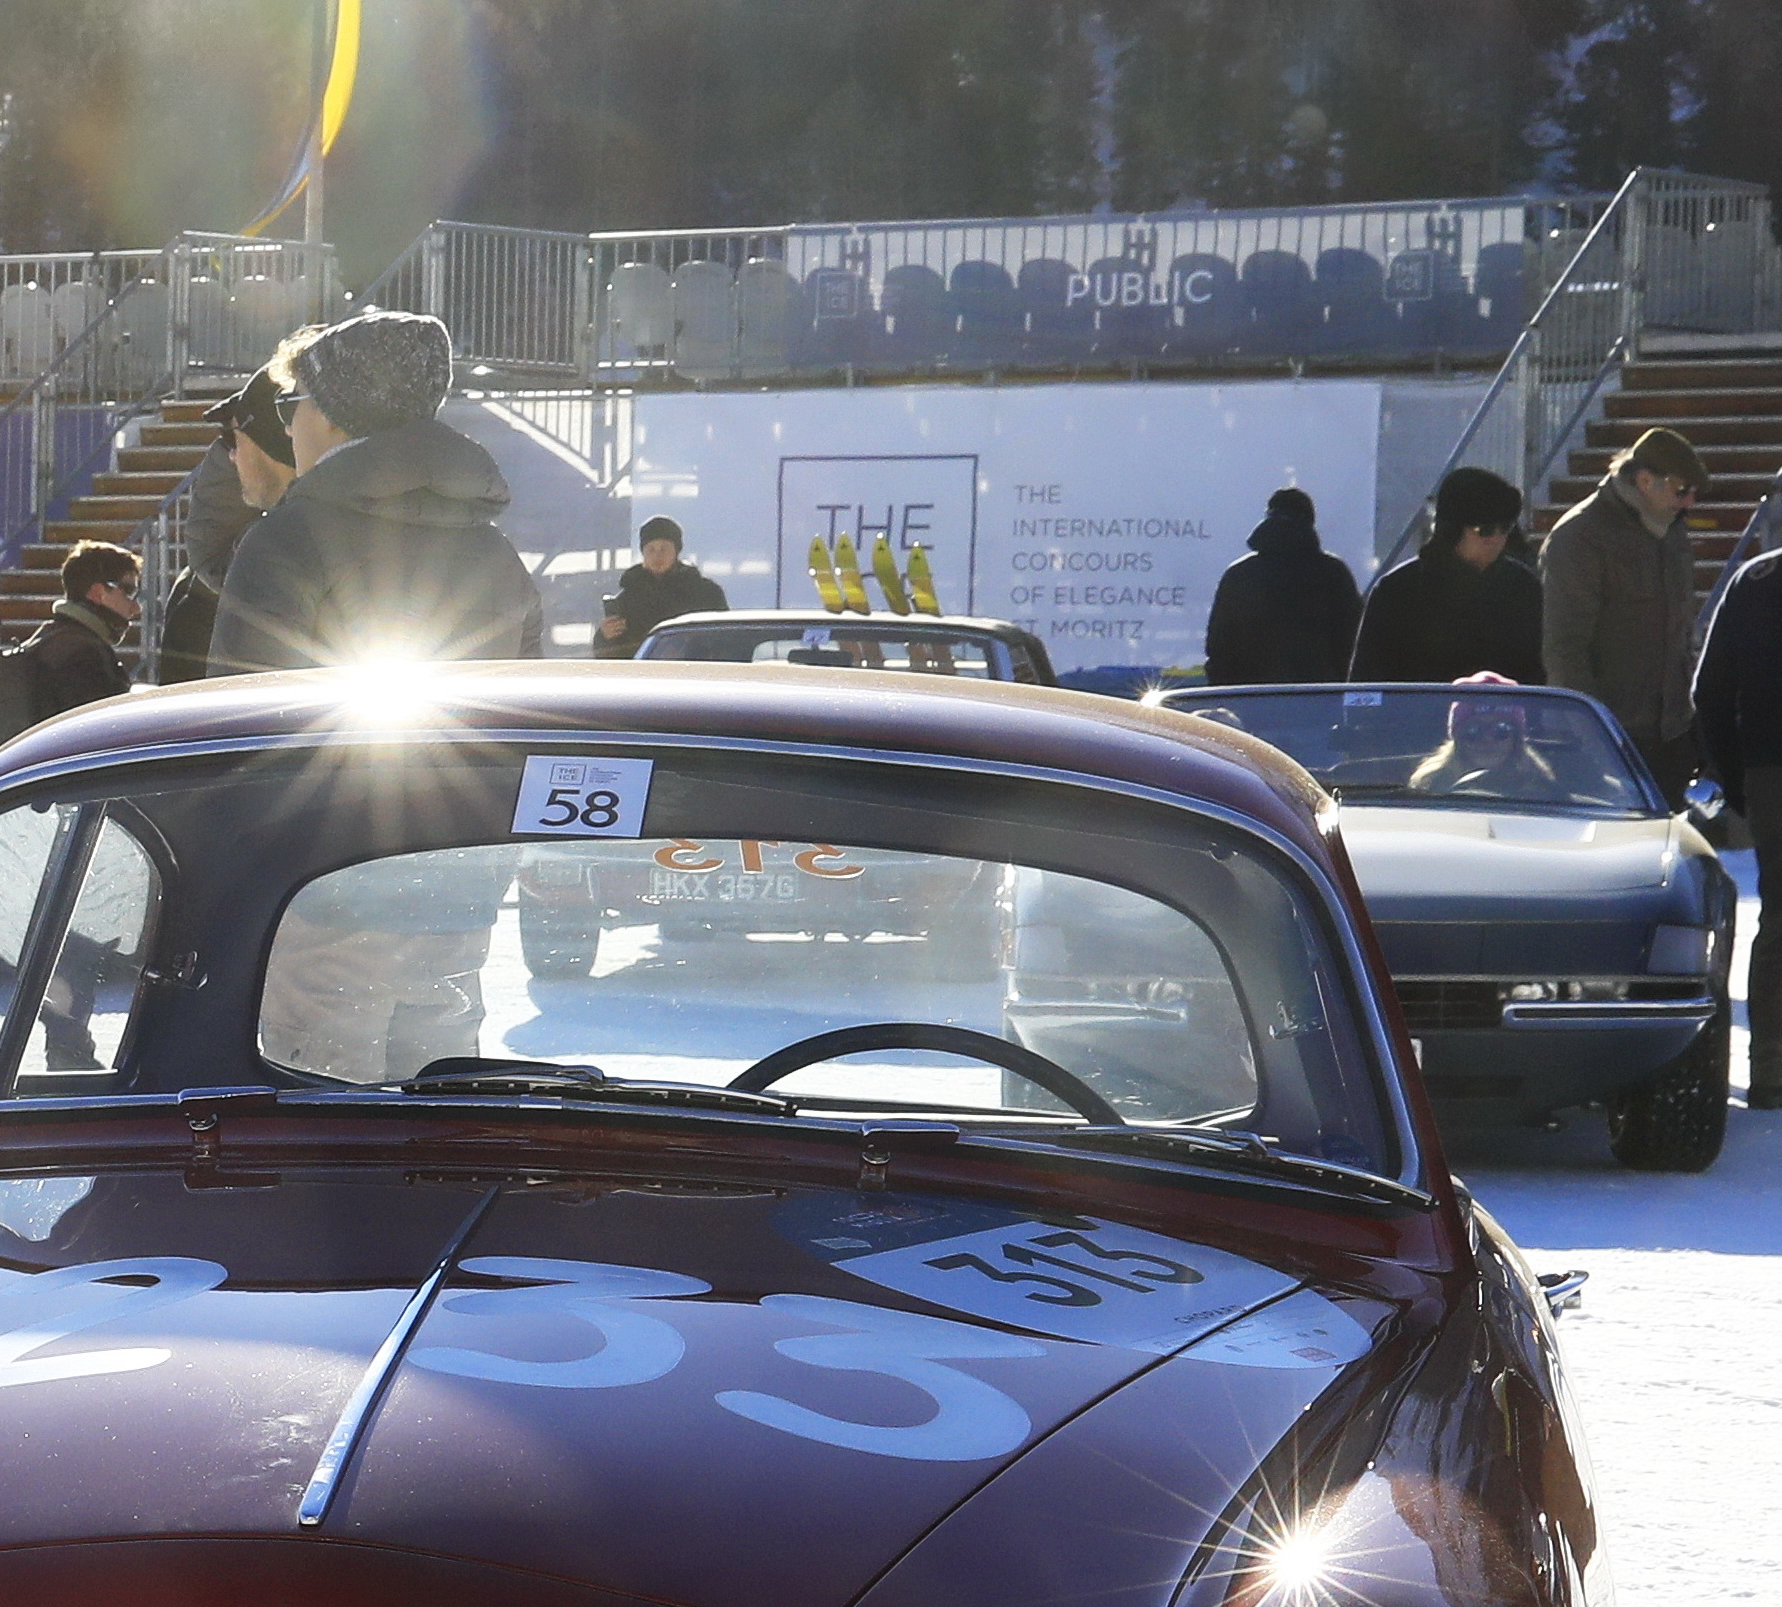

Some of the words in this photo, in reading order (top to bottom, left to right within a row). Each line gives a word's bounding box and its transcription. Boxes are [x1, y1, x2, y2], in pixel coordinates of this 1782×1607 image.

[1065, 270, 1214, 307] PUBLIC
[1014, 484, 1062, 504] THE
[816, 504, 935, 551] THE
[1012, 518, 1213, 539] INTERNATIONAL
[1011, 551, 1154, 572] CONCOURS
[1010, 586, 1045, 605] OF
[1053, 586, 1186, 606] ELEGANCE
[1050, 619, 1145, 640] MORITZ
[538, 788, 621, 829] 58
[652, 871, 710, 898] HKX
[922, 1230, 1205, 1308] 313
